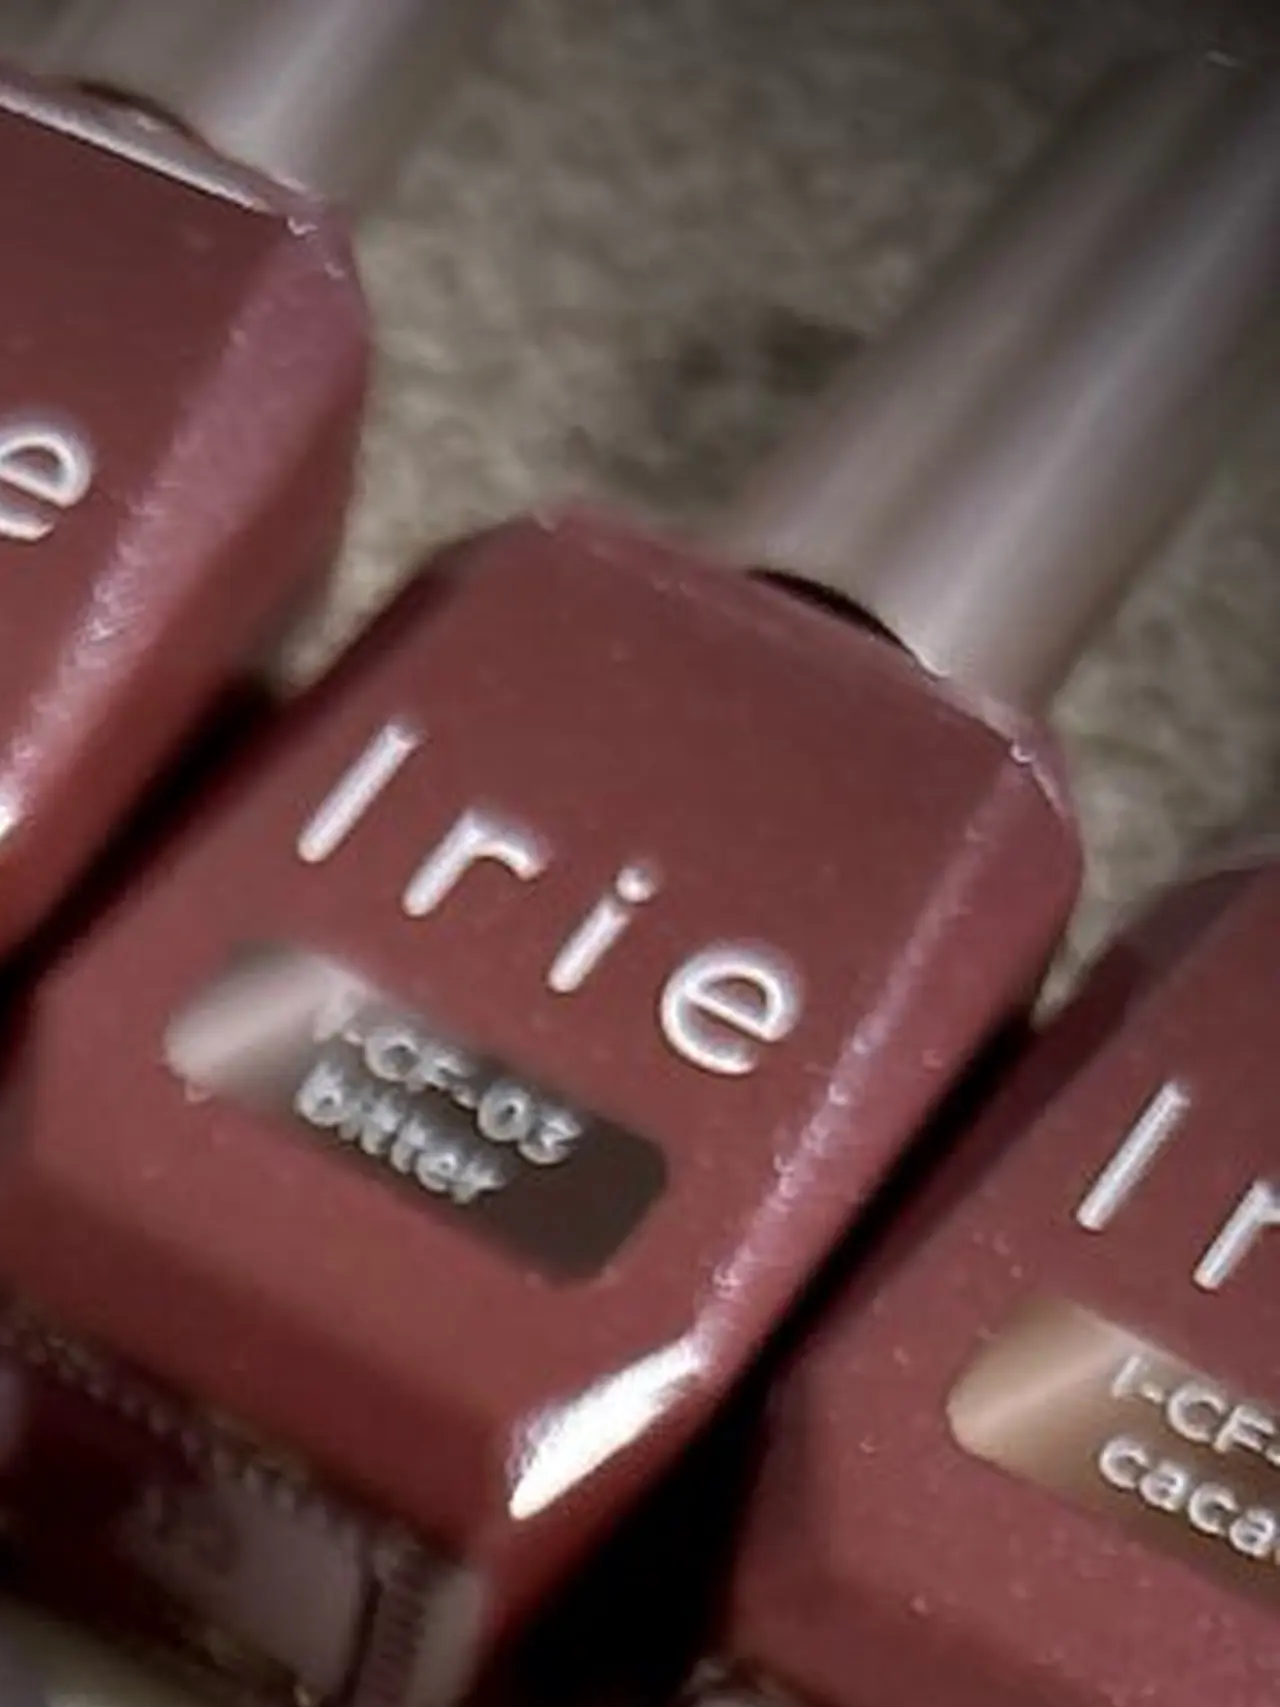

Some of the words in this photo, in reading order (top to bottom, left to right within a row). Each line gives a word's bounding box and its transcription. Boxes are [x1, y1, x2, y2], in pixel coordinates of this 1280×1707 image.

[297, 722, 802, 1076] Irie
[295, 1062, 506, 1204] bitter
[1098, 1434, 1280, 1566] caca
